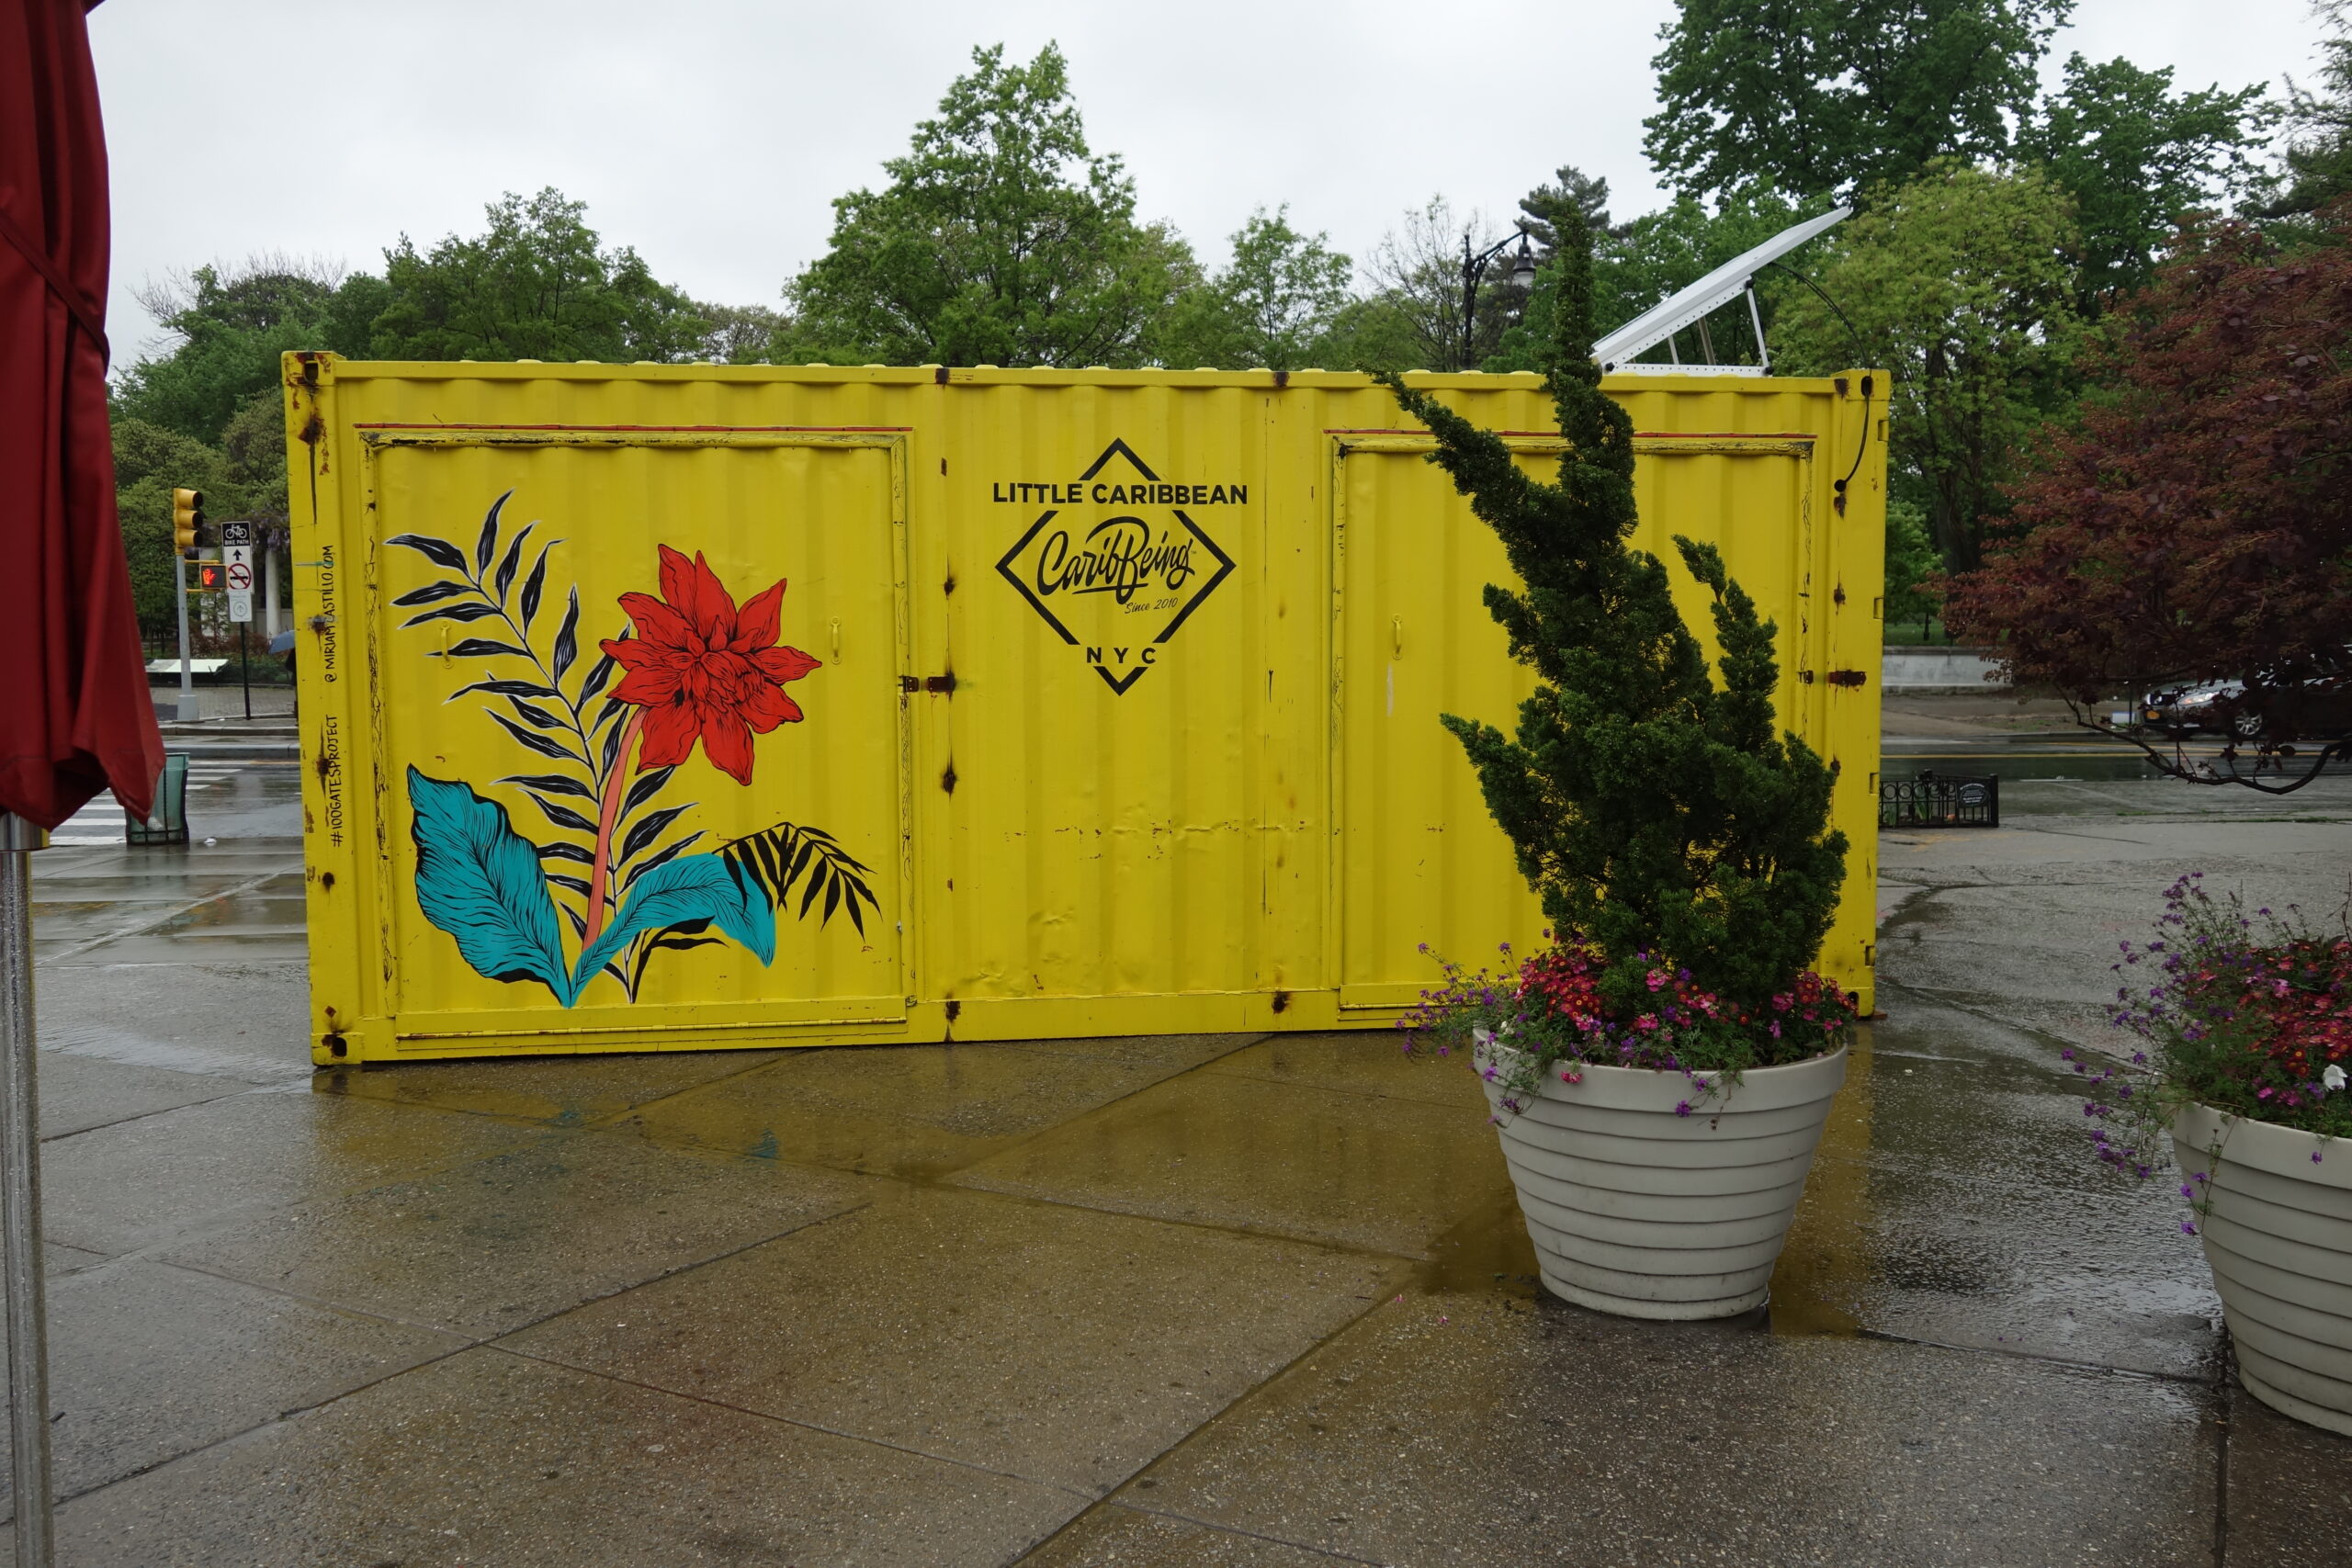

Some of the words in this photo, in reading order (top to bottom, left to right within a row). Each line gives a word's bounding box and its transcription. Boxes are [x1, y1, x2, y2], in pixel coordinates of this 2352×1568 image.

[993, 482, 1082, 503] LITTLE
[1091, 484, 1248, 505] CARIBBEAN
[1124, 602, 1149, 615] Since
[1153, 597, 1178, 610] 2010
[325, 714, 344, 848] #100GATESPROJECT
